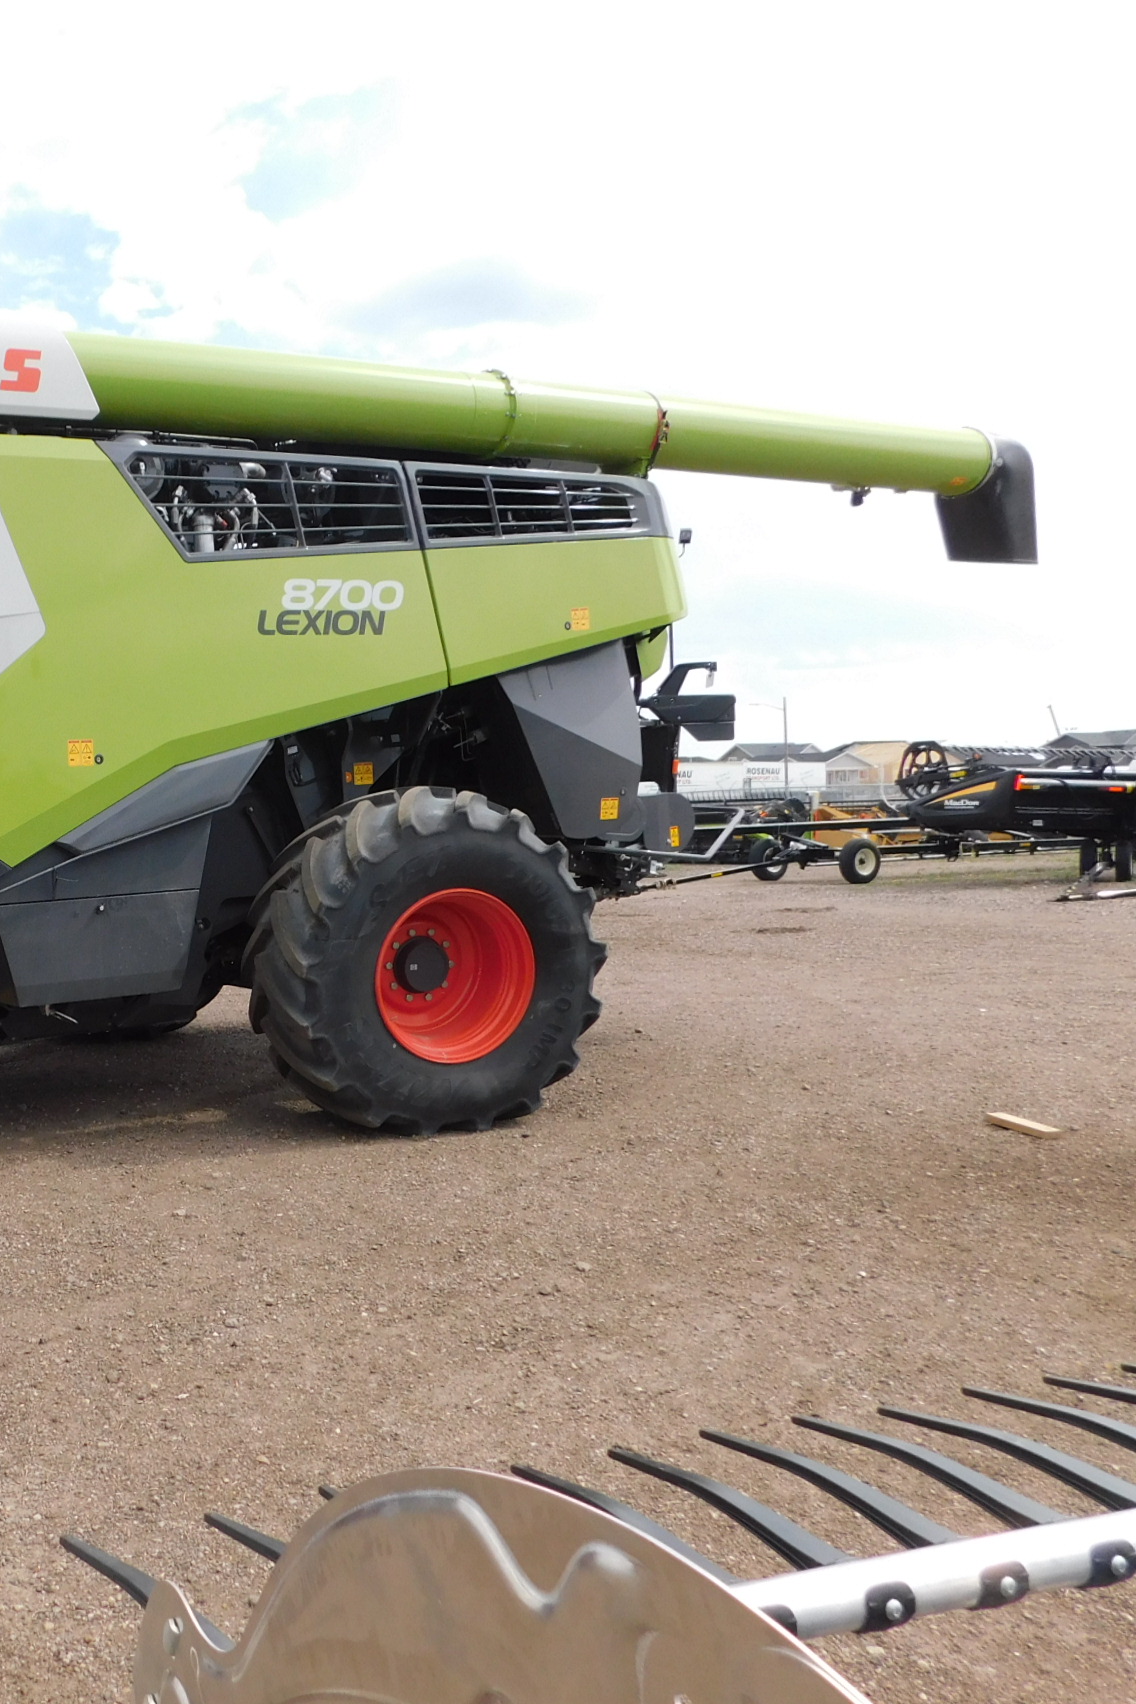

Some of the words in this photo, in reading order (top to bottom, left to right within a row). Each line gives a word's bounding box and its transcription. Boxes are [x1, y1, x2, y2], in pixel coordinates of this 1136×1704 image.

[281, 577, 404, 611] 8700
[257, 609, 386, 636] LEXION
[746, 767, 780, 775] ROSENAU
